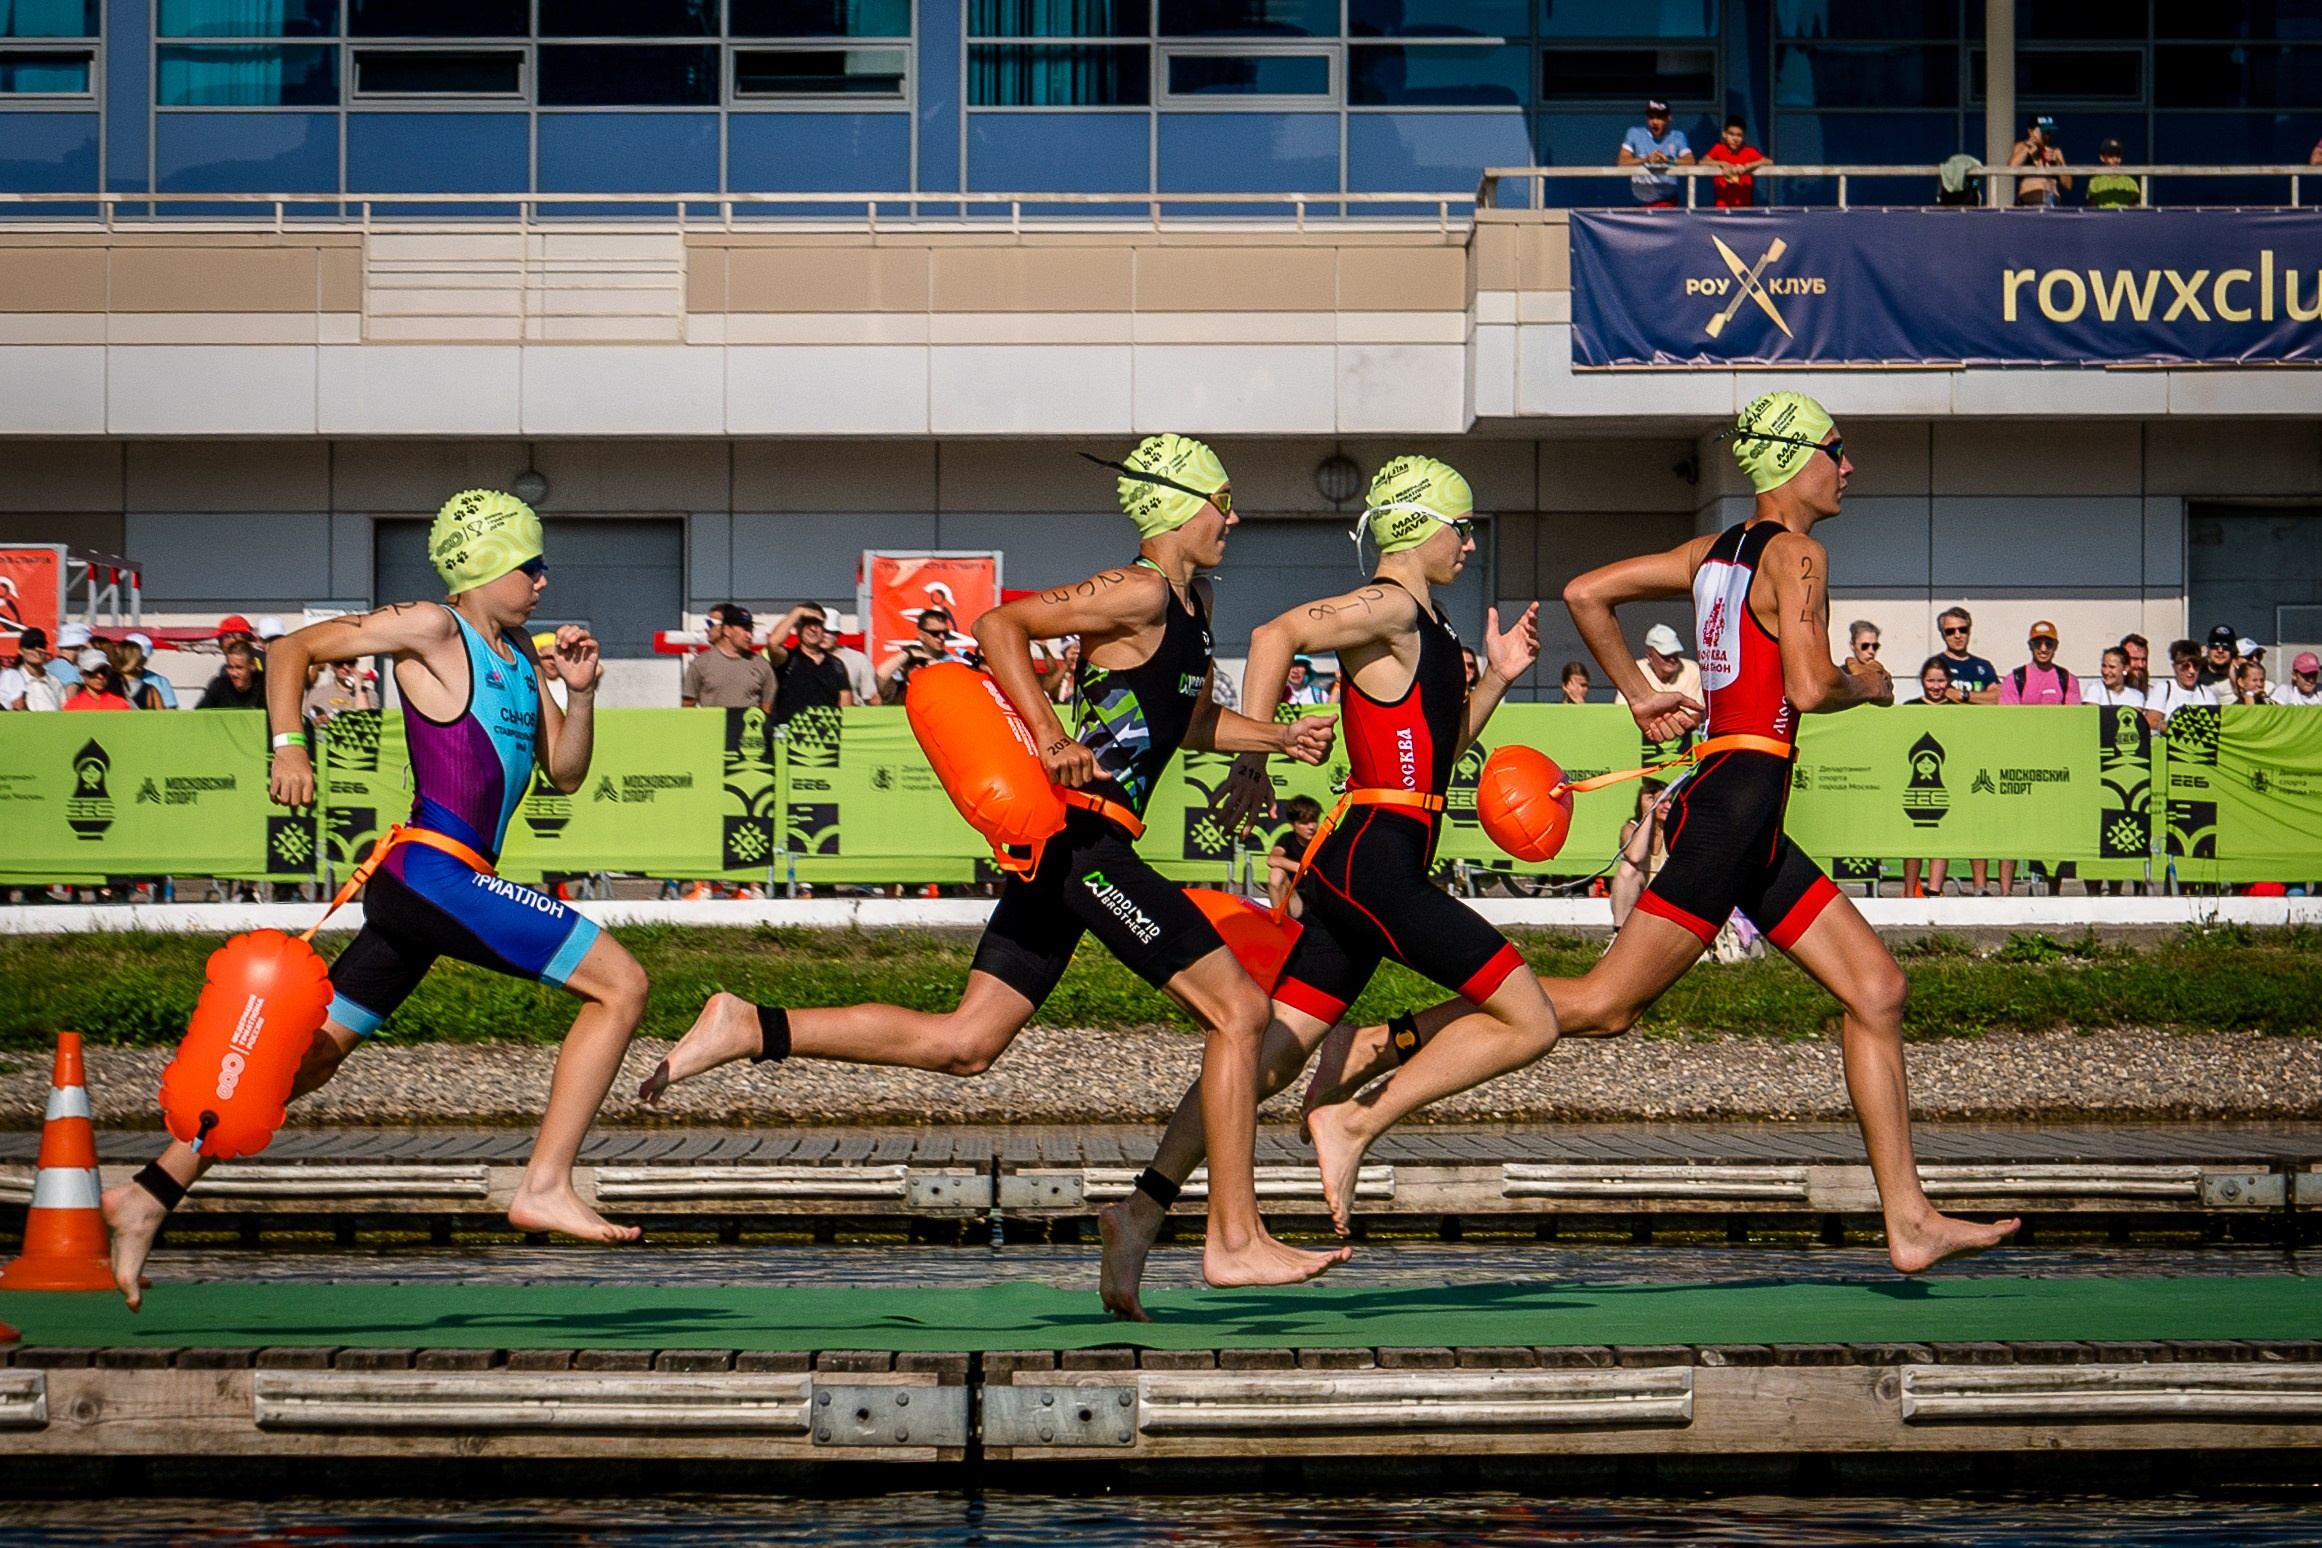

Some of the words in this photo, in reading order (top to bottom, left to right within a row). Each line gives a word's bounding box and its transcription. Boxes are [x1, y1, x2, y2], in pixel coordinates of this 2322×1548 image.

[1685, 277, 1731, 296] РОУ
[1768, 276, 1827, 296] КЛУБ
[1391, 511, 1421, 532] MAD
[1391, 514, 1430, 539] WAVE
[1047, 737, 1071, 756] 203
[1396, 728, 1416, 792] ОСКВА
[1999, 766, 2070, 783] МОСКОВСКИЙ
[1999, 782, 2033, 795] СПОРТ
[1100, 895, 1153, 945] BROTHERS
